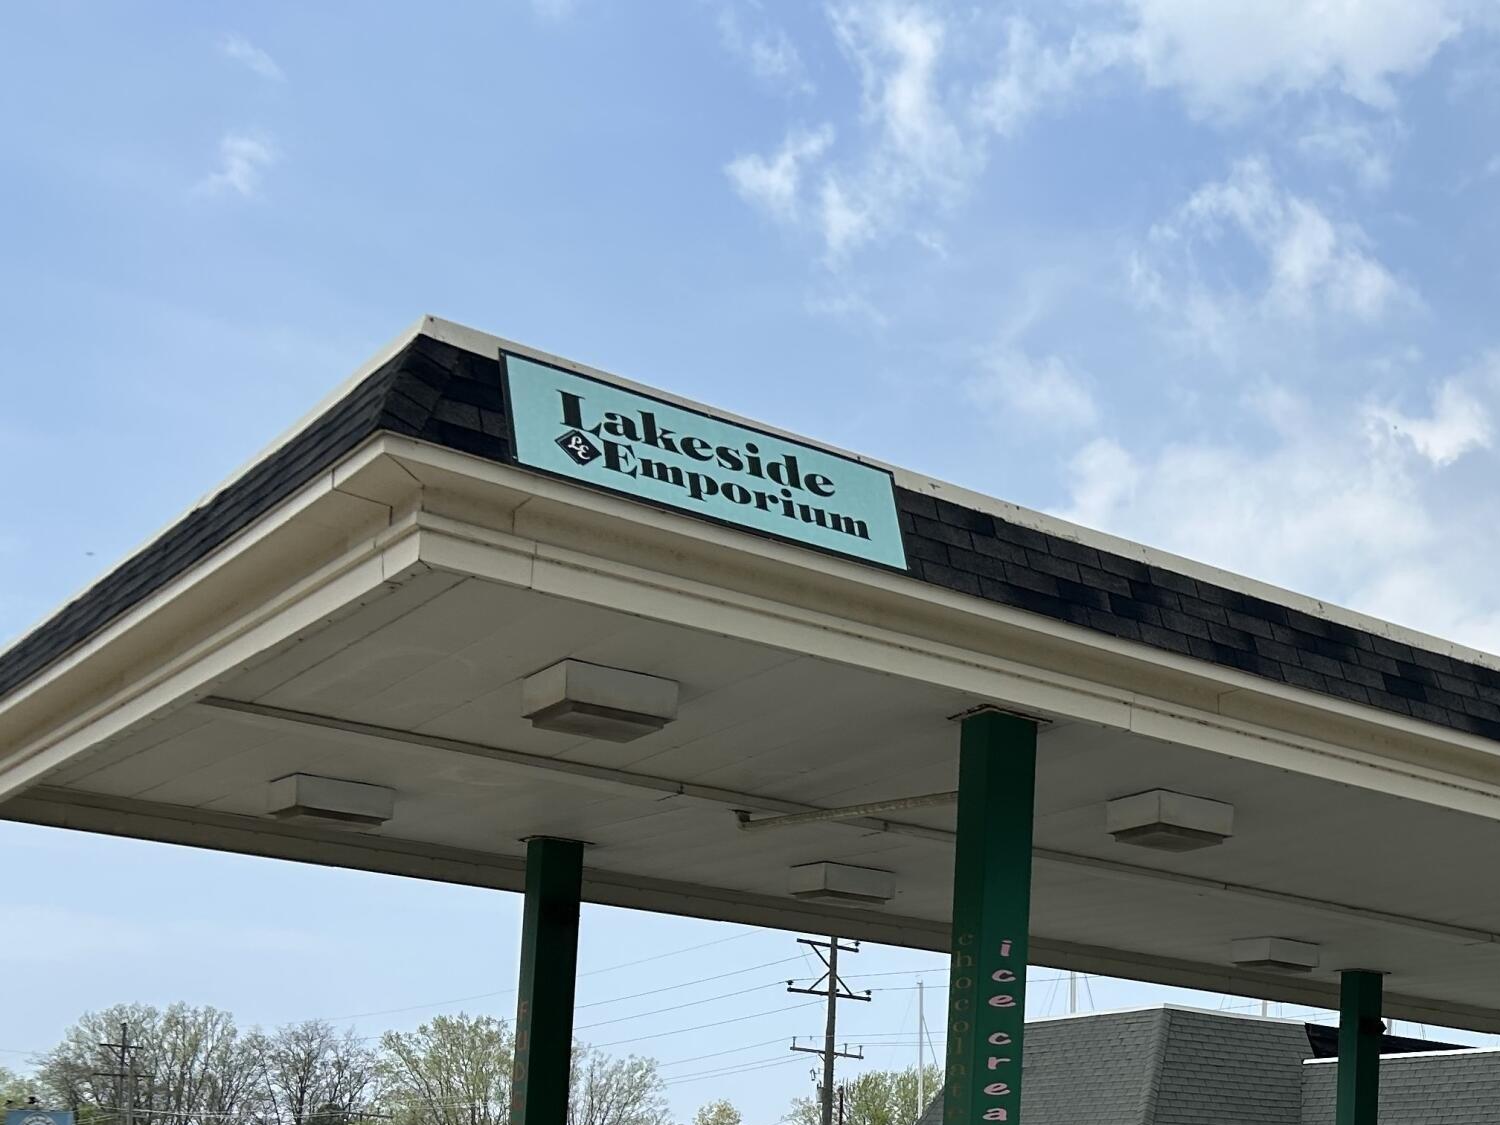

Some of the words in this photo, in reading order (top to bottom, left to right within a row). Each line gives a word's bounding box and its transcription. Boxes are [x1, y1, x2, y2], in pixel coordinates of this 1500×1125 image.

[556, 389, 835, 497] Lakeside
[601, 438, 872, 541] Emporium
[988, 939, 1017, 1008] ice
